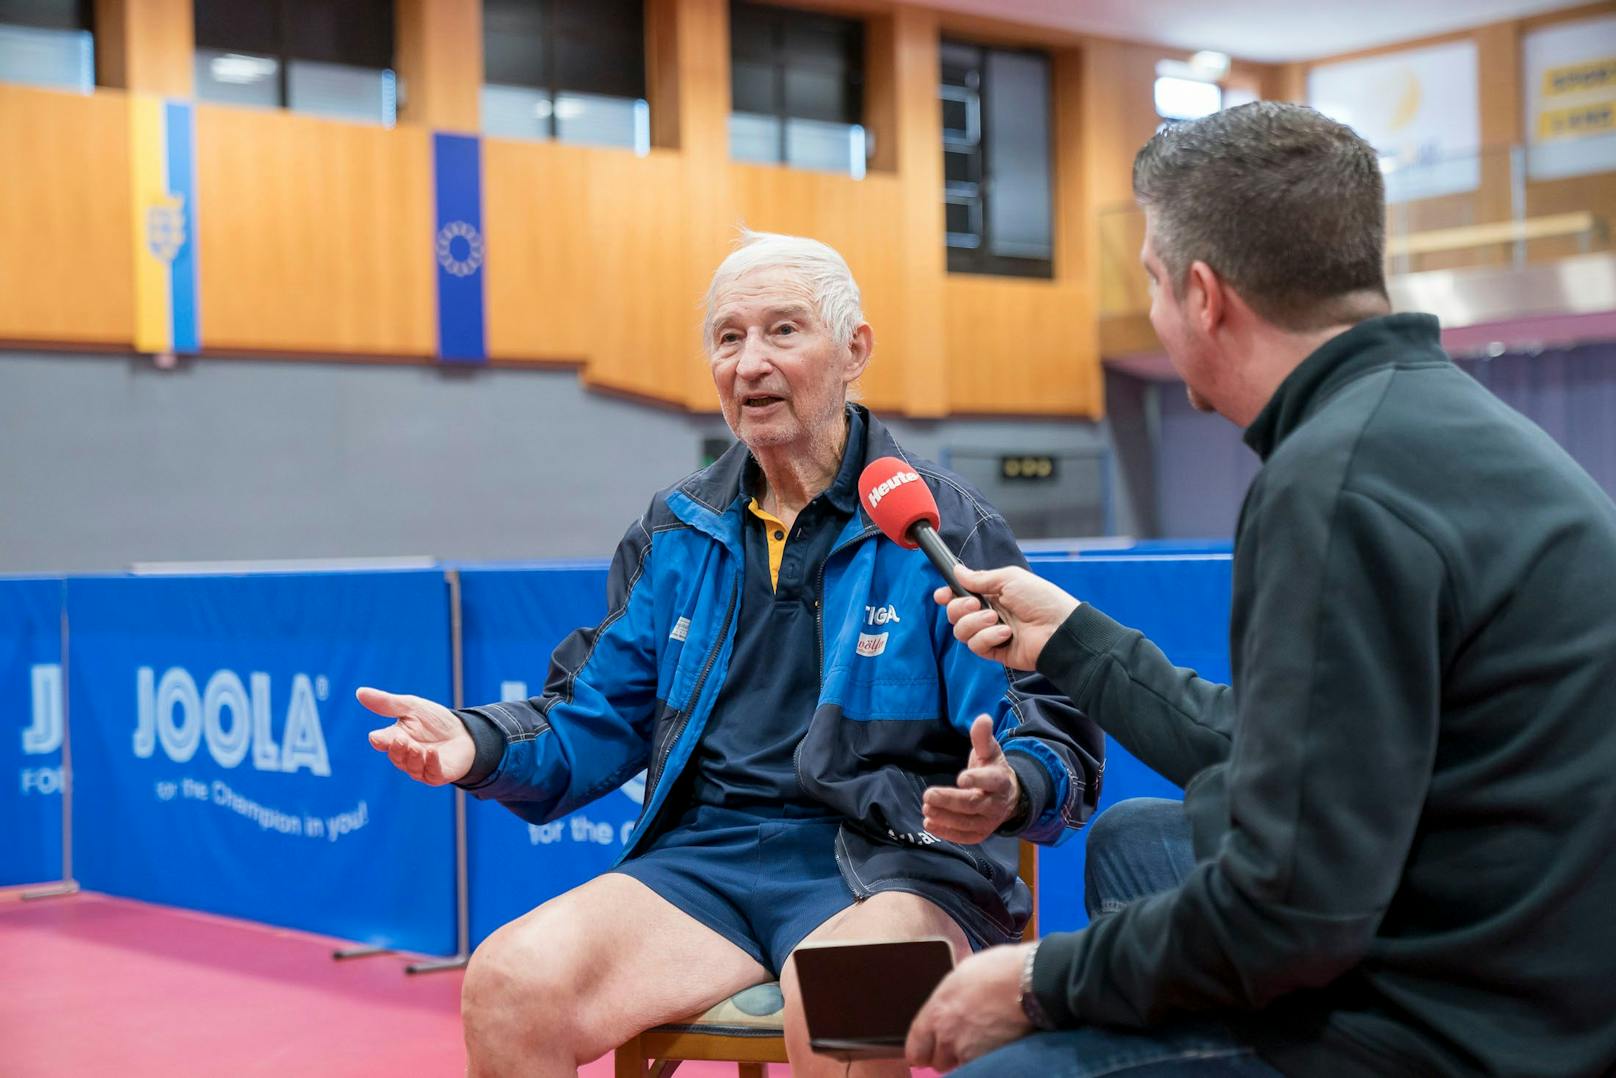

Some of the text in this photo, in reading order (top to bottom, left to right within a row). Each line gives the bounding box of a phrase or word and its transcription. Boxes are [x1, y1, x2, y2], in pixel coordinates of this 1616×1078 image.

[868, 471, 919, 509] Heute
[133, 666, 332, 777] JOOLA
[182, 778, 208, 801] the
[212, 780, 302, 835] Champion
[304, 813, 324, 838] in
[326, 800, 369, 842] you!
[570, 815, 614, 845] the
